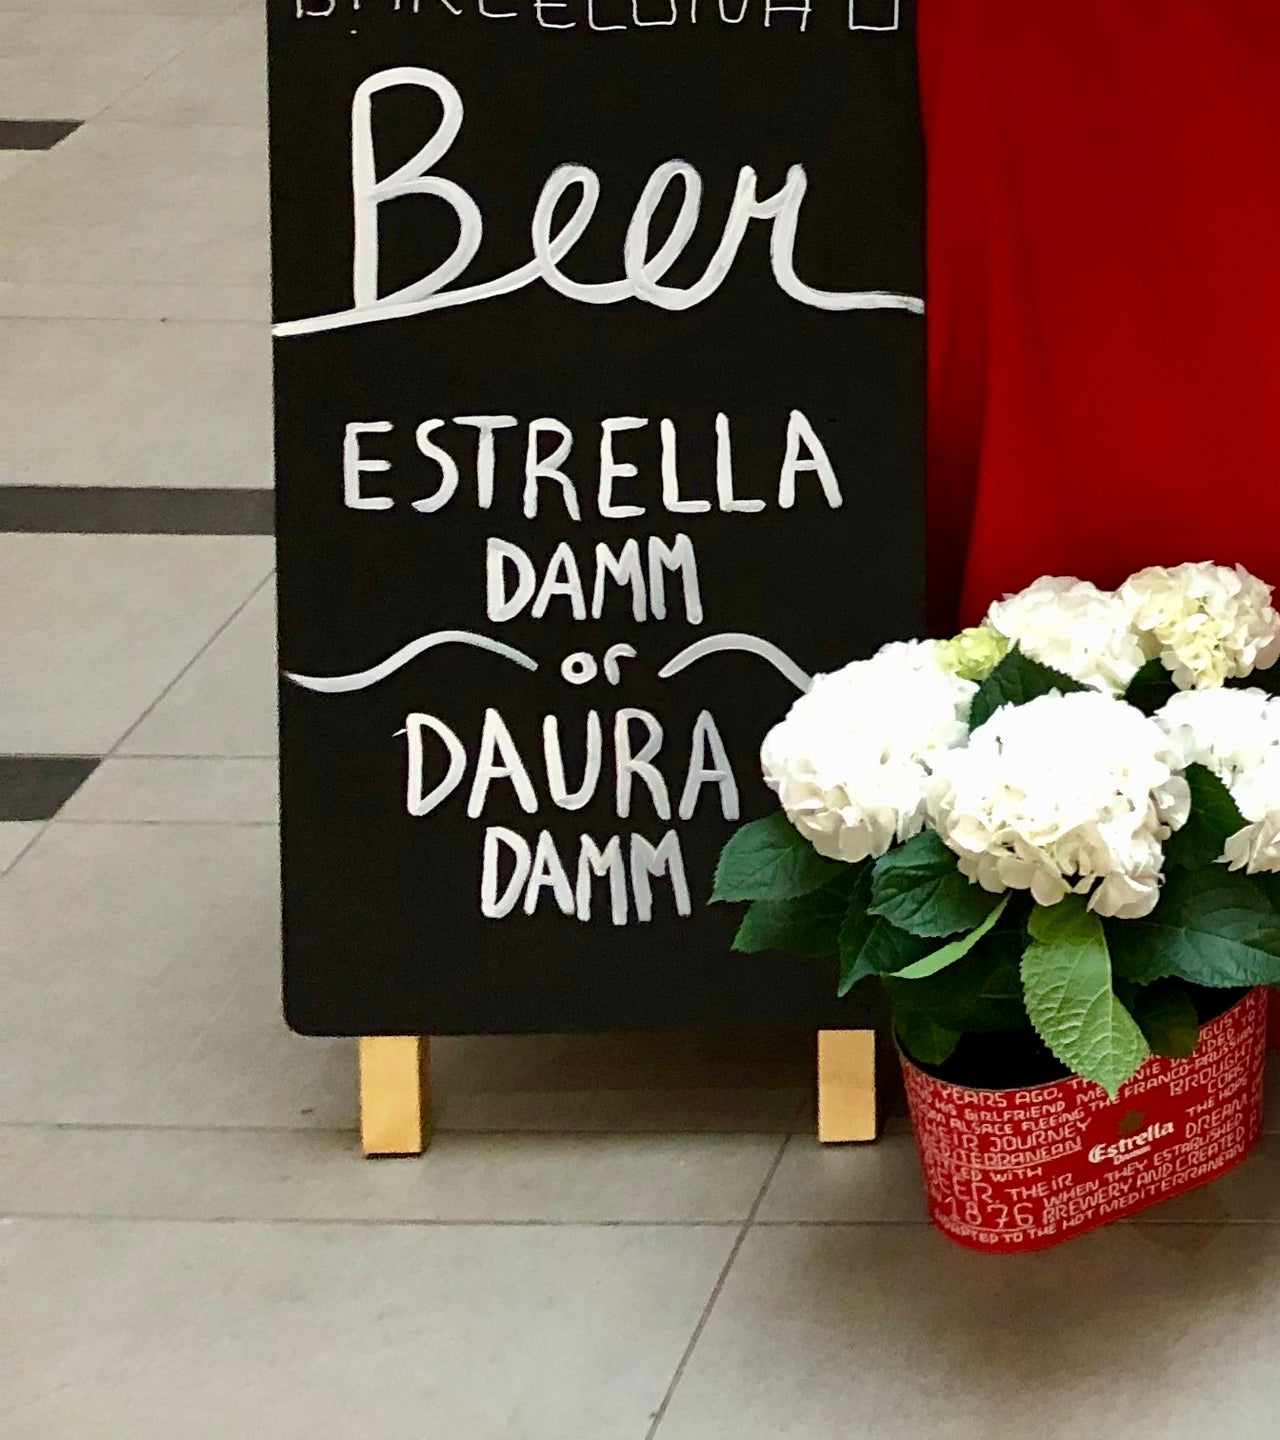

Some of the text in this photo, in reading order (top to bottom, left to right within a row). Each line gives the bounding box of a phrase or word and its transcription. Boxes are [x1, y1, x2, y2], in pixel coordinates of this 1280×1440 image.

[272, 66, 925, 338] Beer
[343, 410, 844, 521] ESTRELLA
[486, 533, 704, 625] DAMM
[560, 643, 638, 686] or
[404, 707, 741, 821] DAURA
[481, 826, 692, 926] DAMM
[989, 1119, 1091, 1153] JOURNEY
[1088, 1121, 1175, 1164] Estrella
